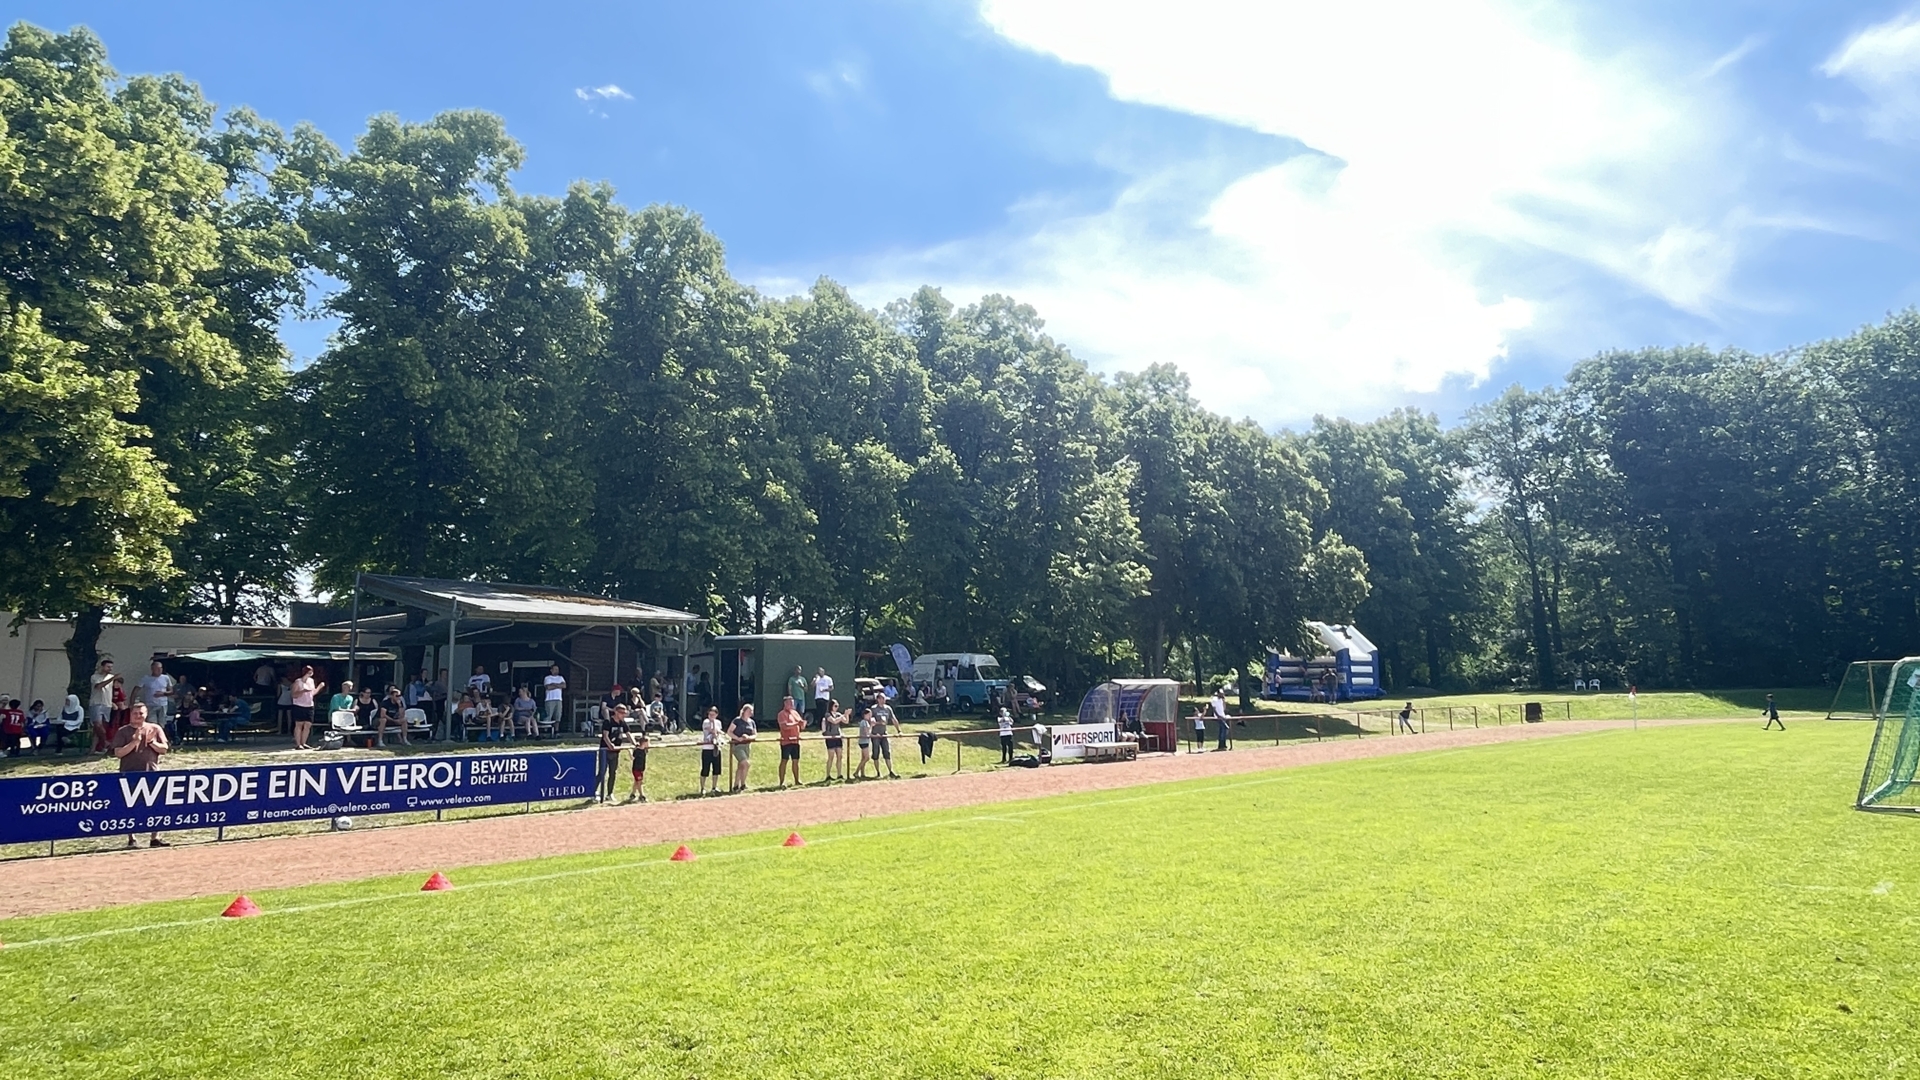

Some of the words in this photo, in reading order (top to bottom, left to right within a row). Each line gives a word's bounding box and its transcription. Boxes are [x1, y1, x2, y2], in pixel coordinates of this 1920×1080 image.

[1061, 731, 1114, 745] INTERSPORT
[470, 758, 529, 774] BEWIRB
[119, 771, 259, 808] WERDE
[268, 768, 327, 798] EIN
[336, 761, 462, 794] VELERO!
[470, 775, 496, 785] DICH
[498, 772, 528, 784] JETZT!
[36, 780, 98, 800] JOB?
[540, 785, 586, 798] VELERO
[20, 799, 111, 815] WOHNUNG?
[420, 794, 491, 806] www.velero.com
[263, 802, 391, 819] team-cottbus@velero.com
[99, 818, 136, 831] 0355
[146, 815, 171, 827] 878
[174, 813, 199, 825] 543
[204, 811, 226, 823] 132
